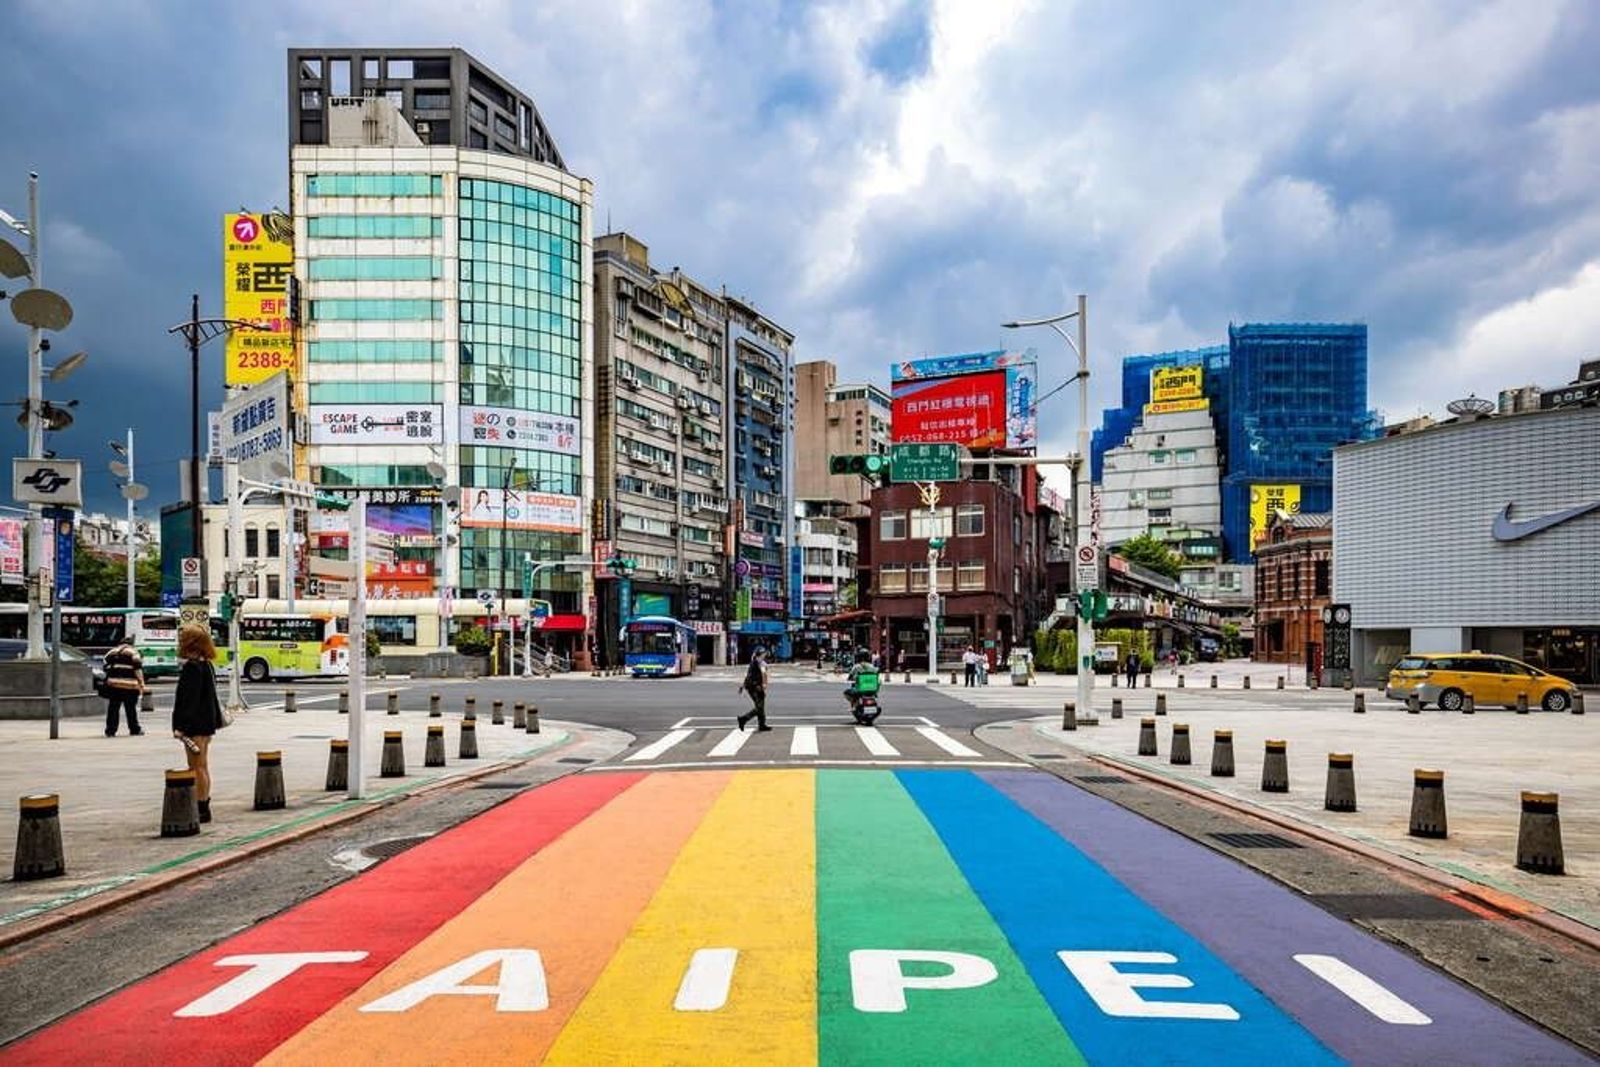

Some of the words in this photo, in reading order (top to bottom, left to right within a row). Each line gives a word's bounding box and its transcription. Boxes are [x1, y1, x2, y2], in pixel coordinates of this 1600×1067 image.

[322, 413, 358, 423] ESCAPE
[406, 411, 432, 423] 密室
[330, 425, 358, 434] GAME
[172, 948, 1434, 1026] TAIPEI
